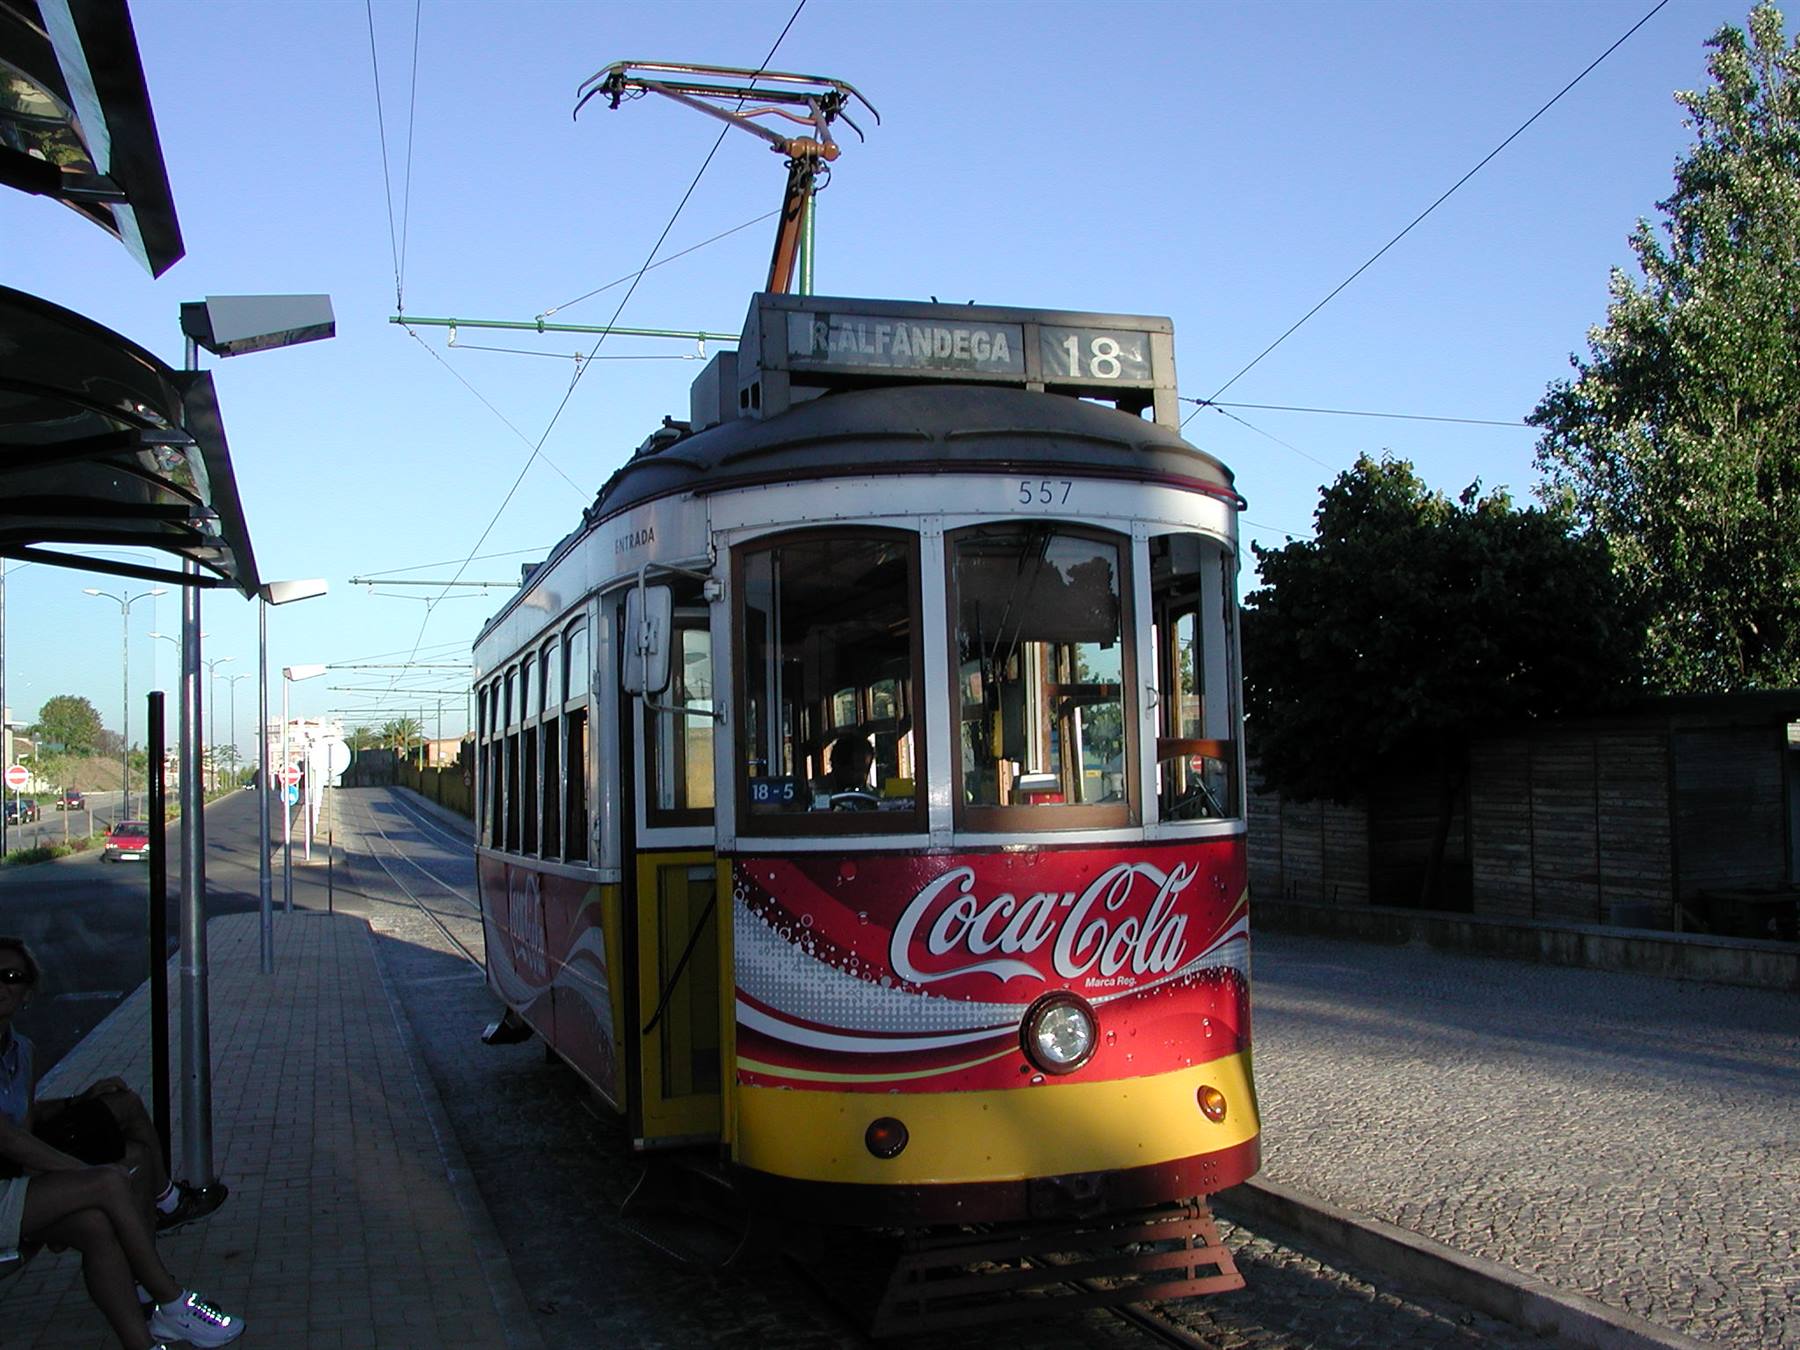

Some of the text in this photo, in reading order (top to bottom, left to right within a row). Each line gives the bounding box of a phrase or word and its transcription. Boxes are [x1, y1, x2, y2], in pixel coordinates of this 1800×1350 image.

[1063, 335, 1121, 379] 18
[1019, 480, 1072, 505] 557
[615, 527, 655, 554] ENTRADA
[1085, 975, 1137, 988] Marca Reg.
